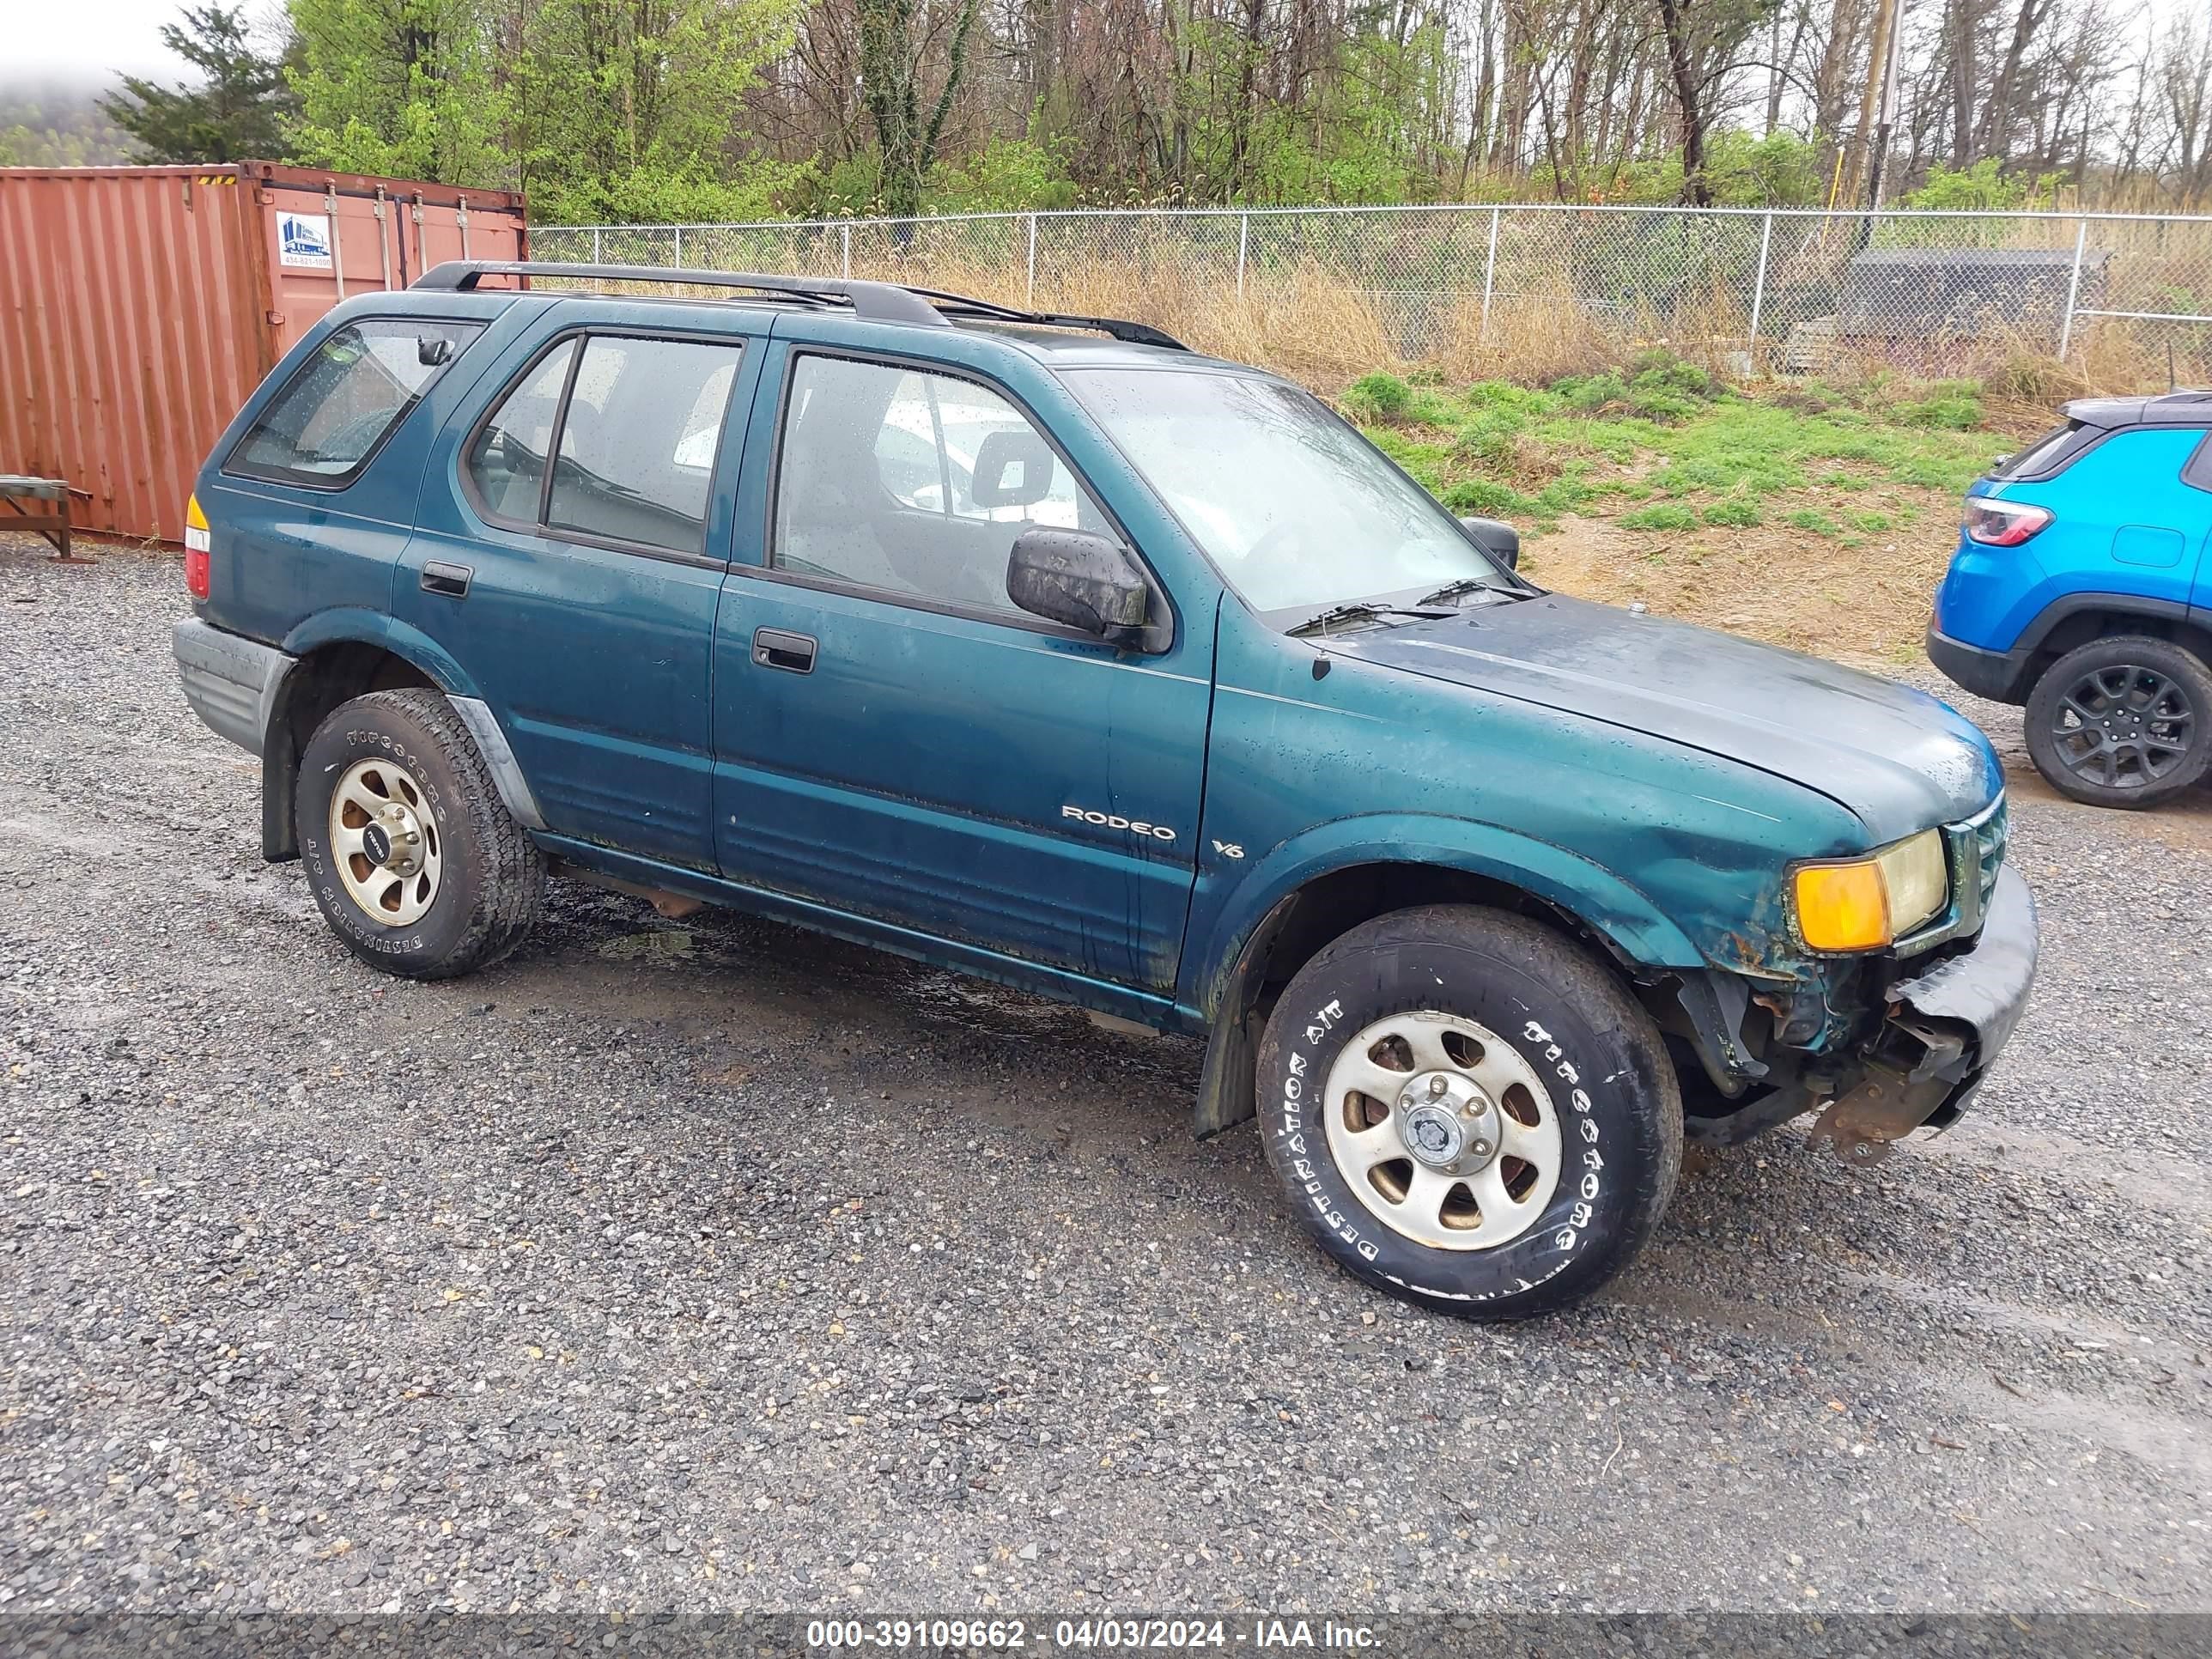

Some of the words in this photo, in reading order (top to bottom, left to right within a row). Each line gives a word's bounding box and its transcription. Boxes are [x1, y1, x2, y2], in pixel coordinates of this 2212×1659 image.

[1061, 805, 1177, 841] RODEO
[307, 838, 324, 876] A/T
[367, 830, 385, 859] ISUZU
[1211, 837, 1245, 859] V6
[321, 885, 423, 955] DESTINATION
[1305, 999, 1344, 1045] A/T
[1284, 1051, 1379, 1261] DESTINATION
